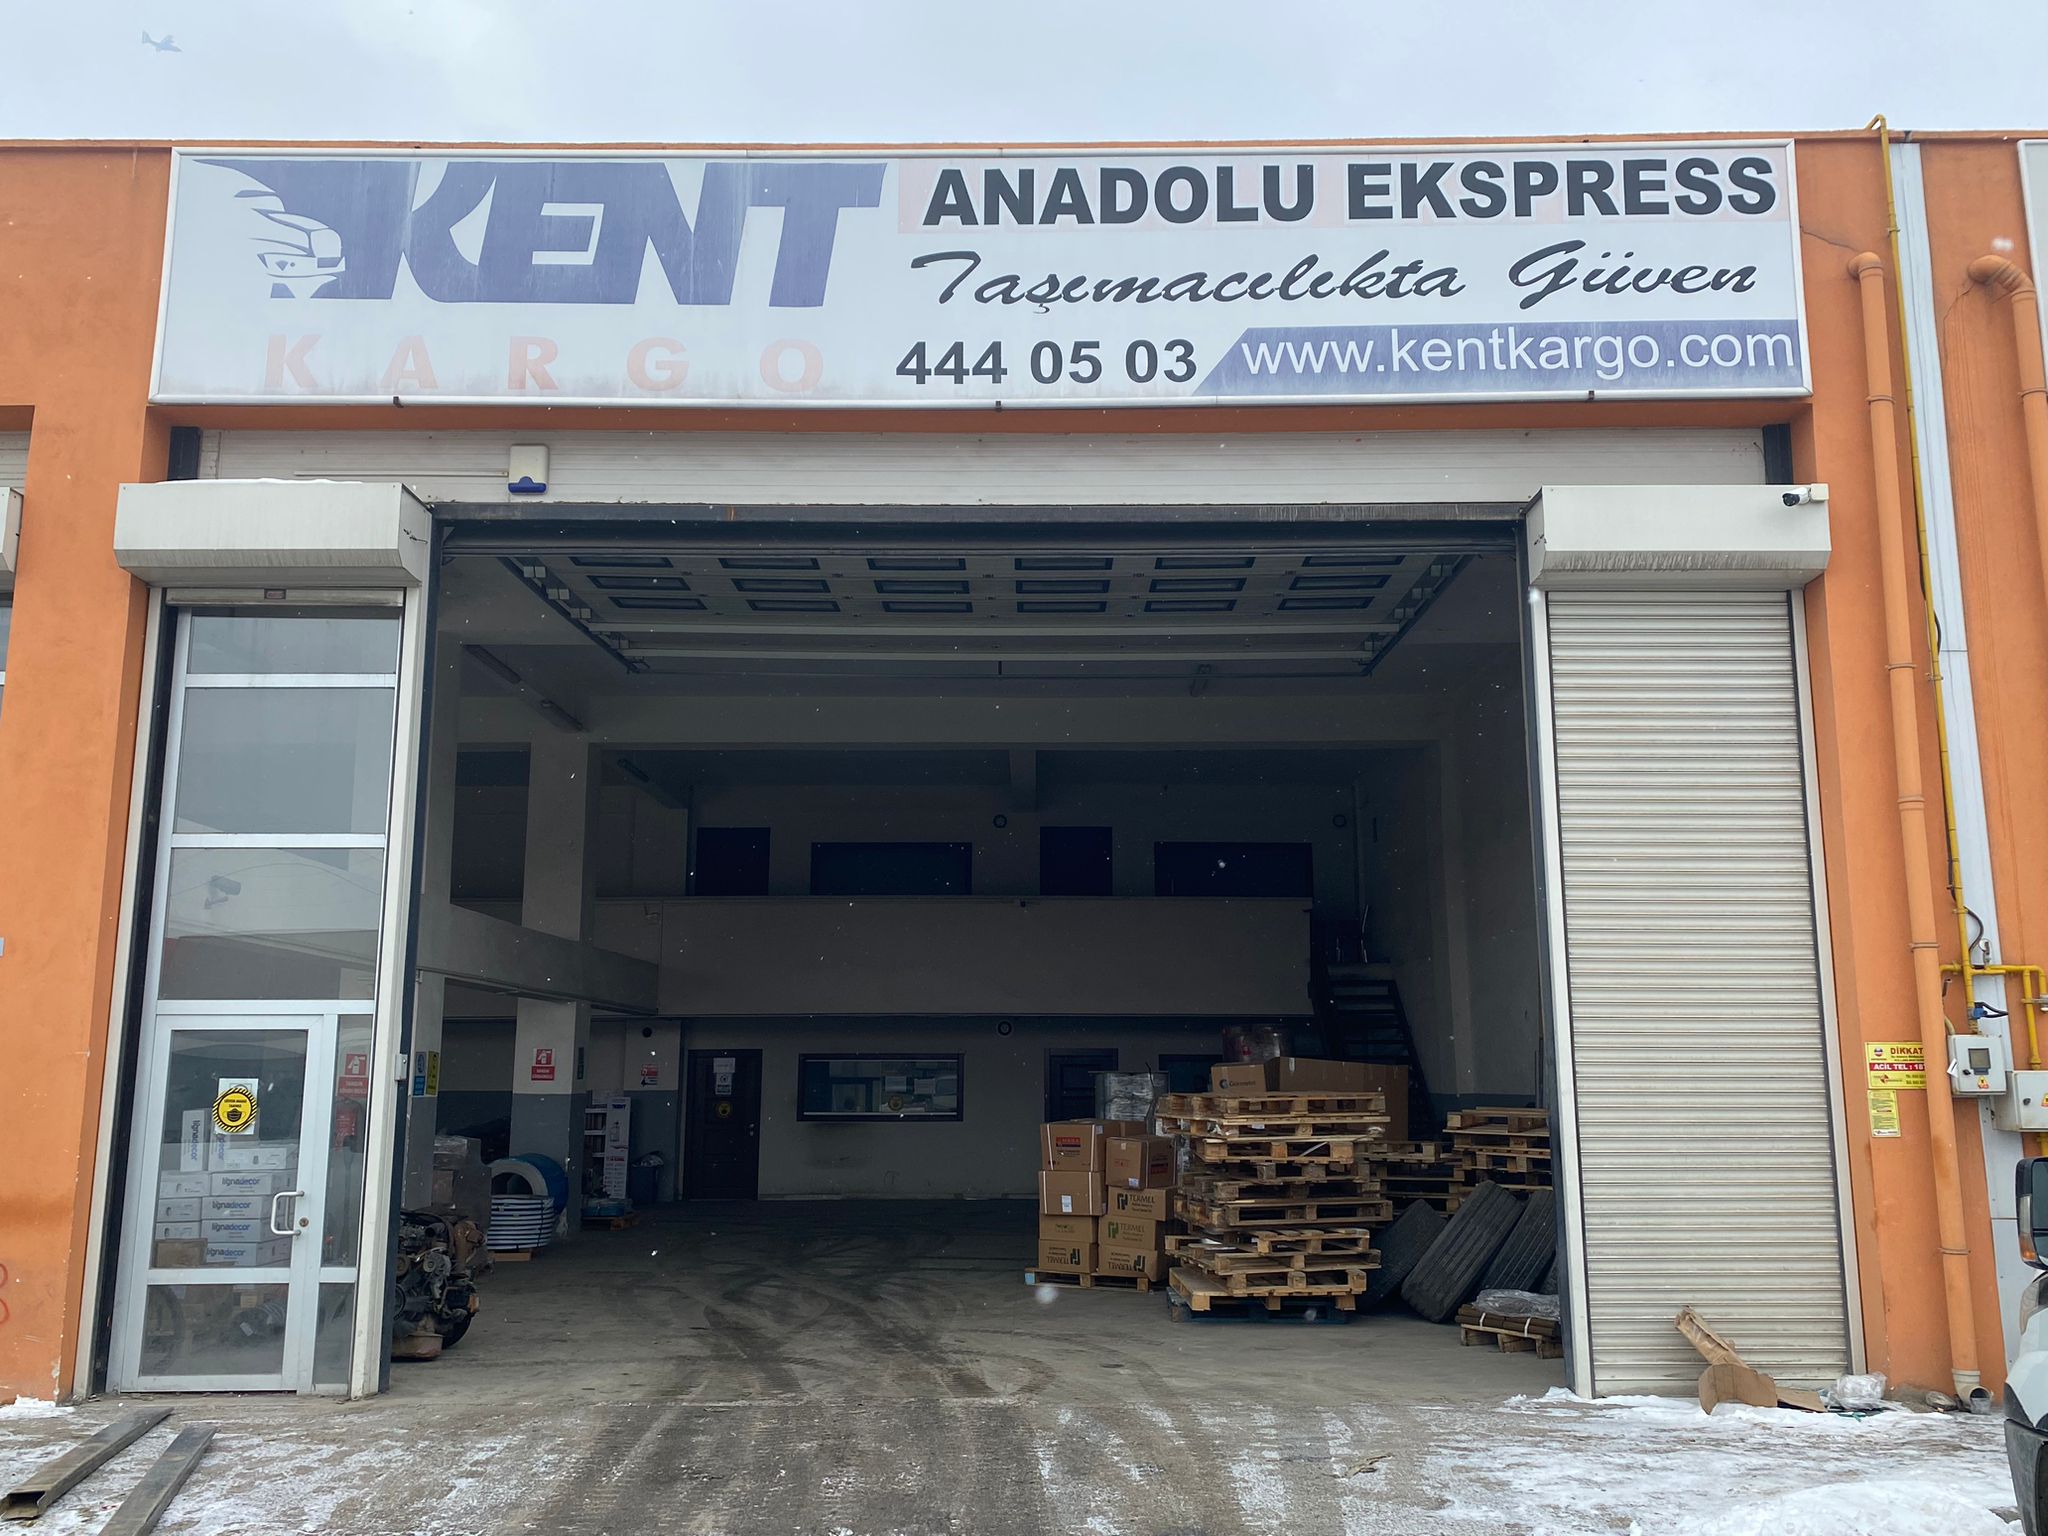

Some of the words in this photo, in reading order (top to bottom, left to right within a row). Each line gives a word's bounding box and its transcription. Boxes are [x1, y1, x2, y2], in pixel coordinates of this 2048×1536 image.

[922, 164, 1315, 226] ANADOLU
[1346, 156, 1777, 220] EKSPRESS
[290, 161, 888, 308] KENT
[910, 248, 1466, 315] Taşımacılıkta
[1508, 239, 1757, 310] Güven
[264, 334, 824, 393] KARGO
[895, 341, 1008, 385] 444
[1029, 340, 1102, 384] 05
[1124, 338, 1198, 384] 03
[1240, 325, 1795, 381] www.kentkargo.com
[1890, 1046, 1924, 1055] DİKKAT
[212, 1200, 252, 1210] lignadecor
[222, 1177, 261, 1186] lignadecor
[211, 1222, 251, 1232] lignadecor
